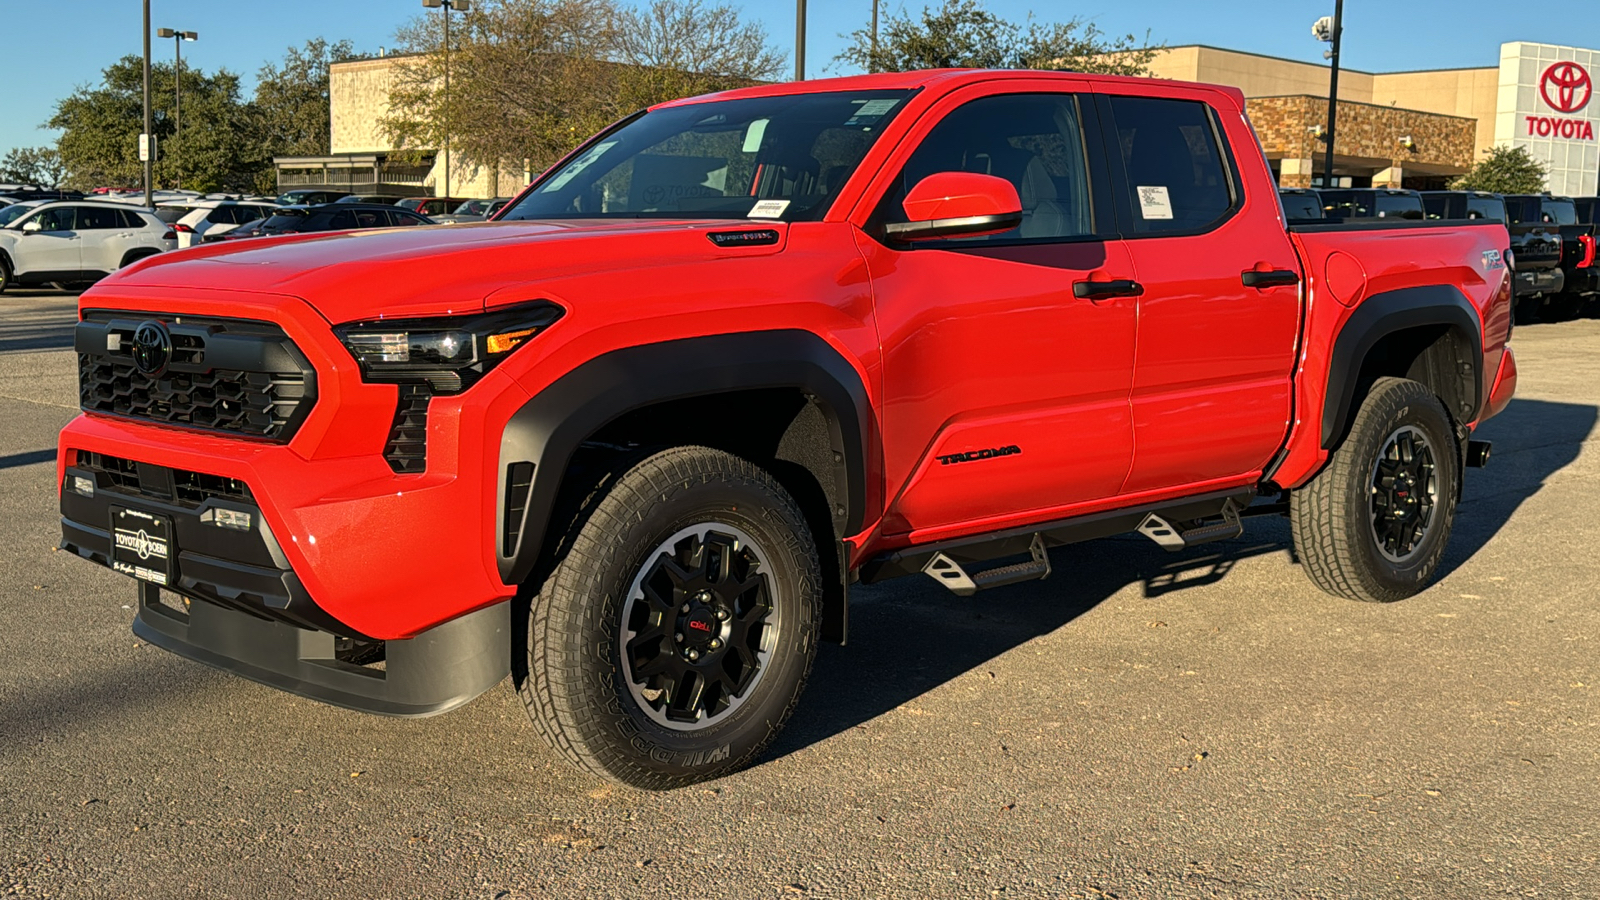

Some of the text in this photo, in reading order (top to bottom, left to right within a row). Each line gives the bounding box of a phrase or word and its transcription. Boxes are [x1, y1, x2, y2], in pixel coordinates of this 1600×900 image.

[1525, 116, 1594, 140] TOYOTA
[667, 185, 711, 198] TOYOTA
[1482, 249, 1500, 264] TRD
[935, 445, 1021, 465] TACOMA
[114, 533, 168, 555] TOYOTA BOERN
[690, 621, 711, 632] TRD
